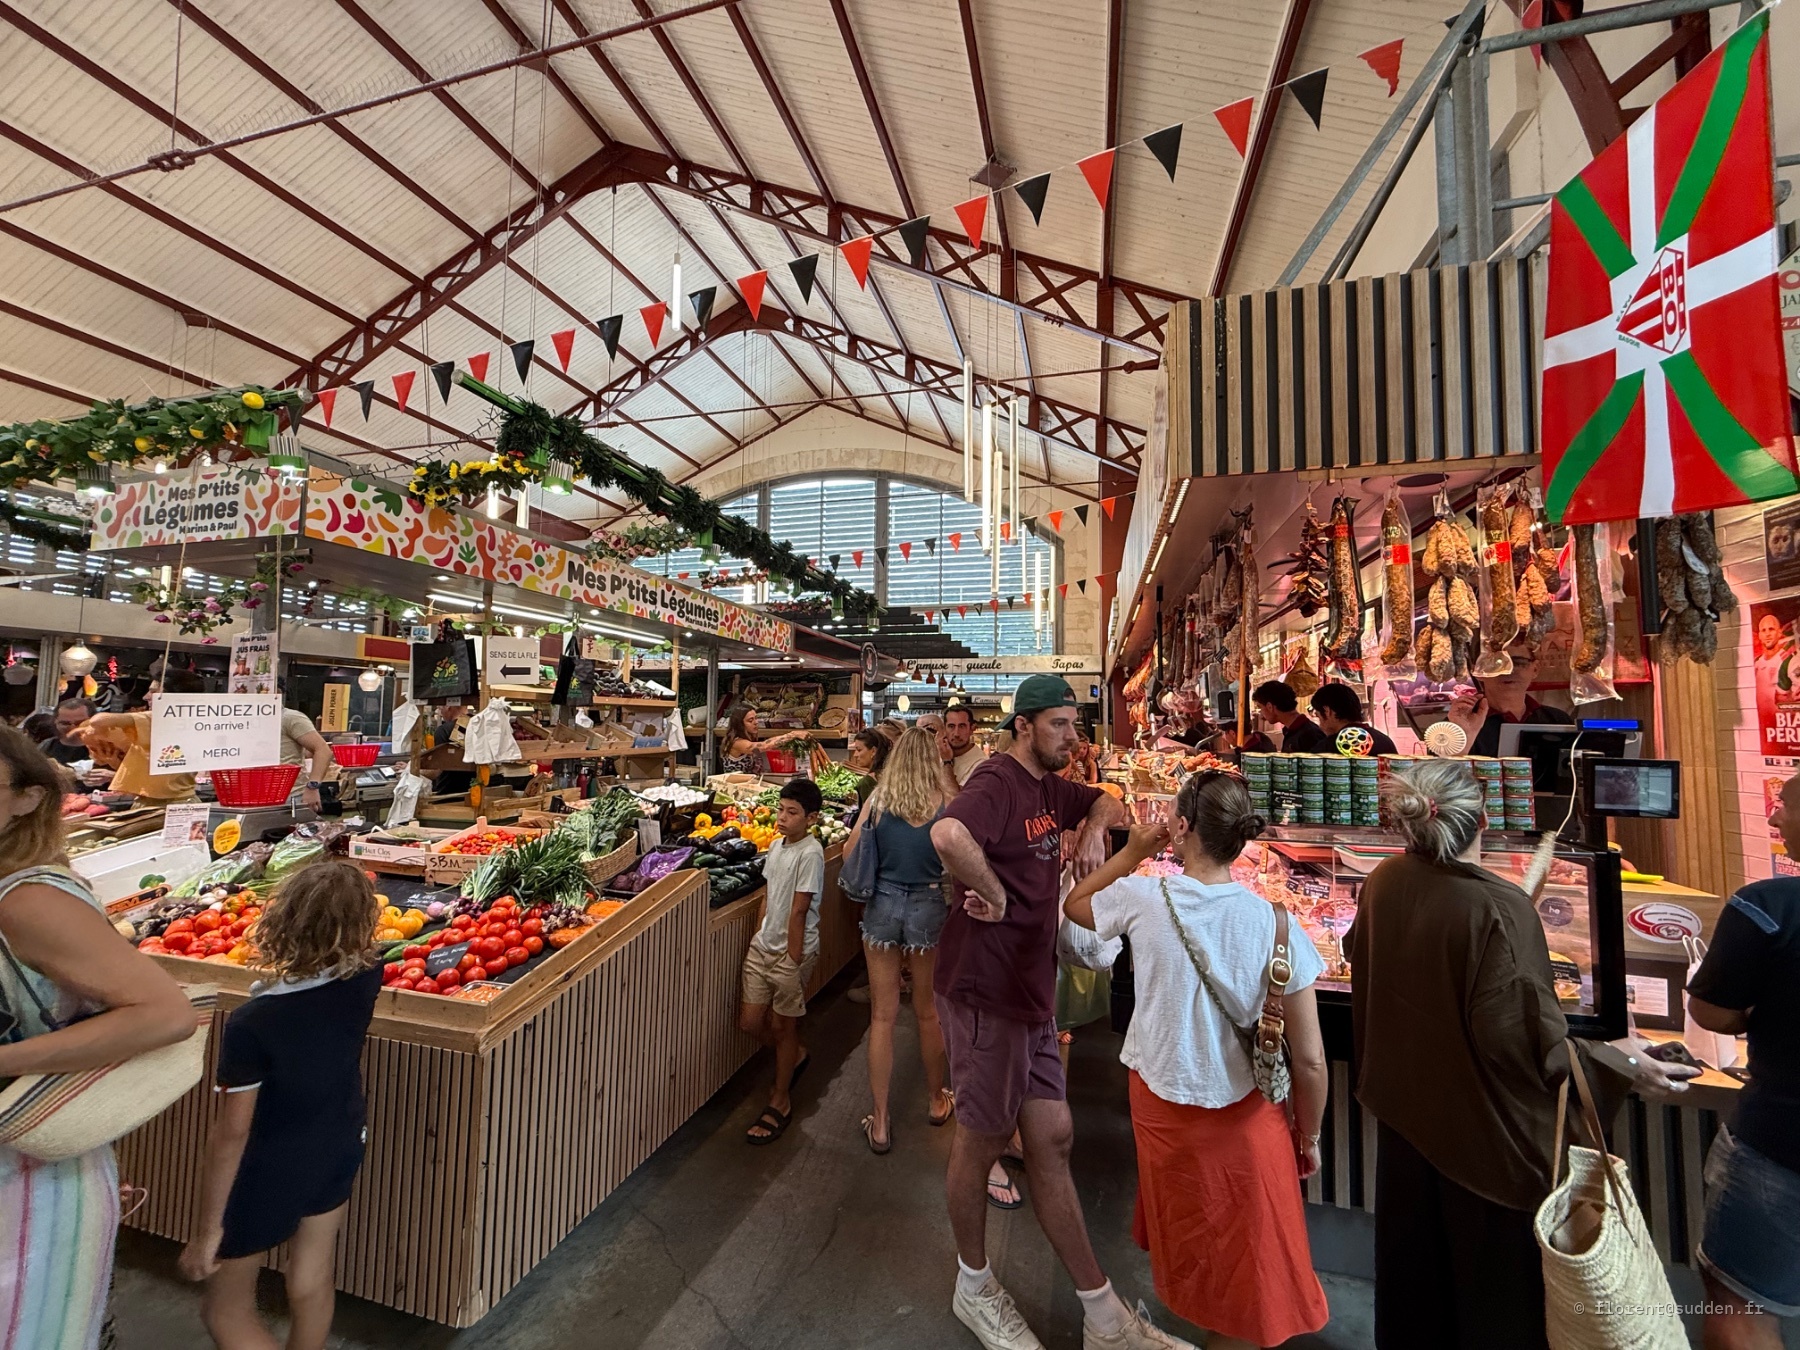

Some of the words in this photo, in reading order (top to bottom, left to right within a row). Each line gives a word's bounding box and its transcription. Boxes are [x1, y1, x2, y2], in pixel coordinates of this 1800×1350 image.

[1661, 262, 1678, 336] BO
[168, 486, 196, 502] Mes
[199, 479, 240, 498] P'tits
[144, 500, 239, 530] Légumes
[179, 523, 208, 534] Marina
[210, 522, 216, 531] &
[217, 520, 237, 532] Paul
[567, 561, 607, 592] Mes
[610, 574, 658, 606] P'tits
[660, 590, 720, 623] Légumes
[685, 616, 703, 627] Marina
[708, 622, 719, 631] Paul
[236, 645, 249, 654] JUS
[249, 644, 270, 653] FRAIS
[489, 651, 507, 659] SENS
[906, 659, 948, 672] L'amuse
[966, 659, 1002, 672] gueule
[1051, 659, 1084, 671] Tapas
[163, 704, 252, 718] ATTENDEZ
[256, 704, 276, 716] ICI
[194, 721, 211, 731] On
[213, 722, 244, 731] arrive
[246, 721, 250, 730] !
[202, 747, 240, 759] MERCI
